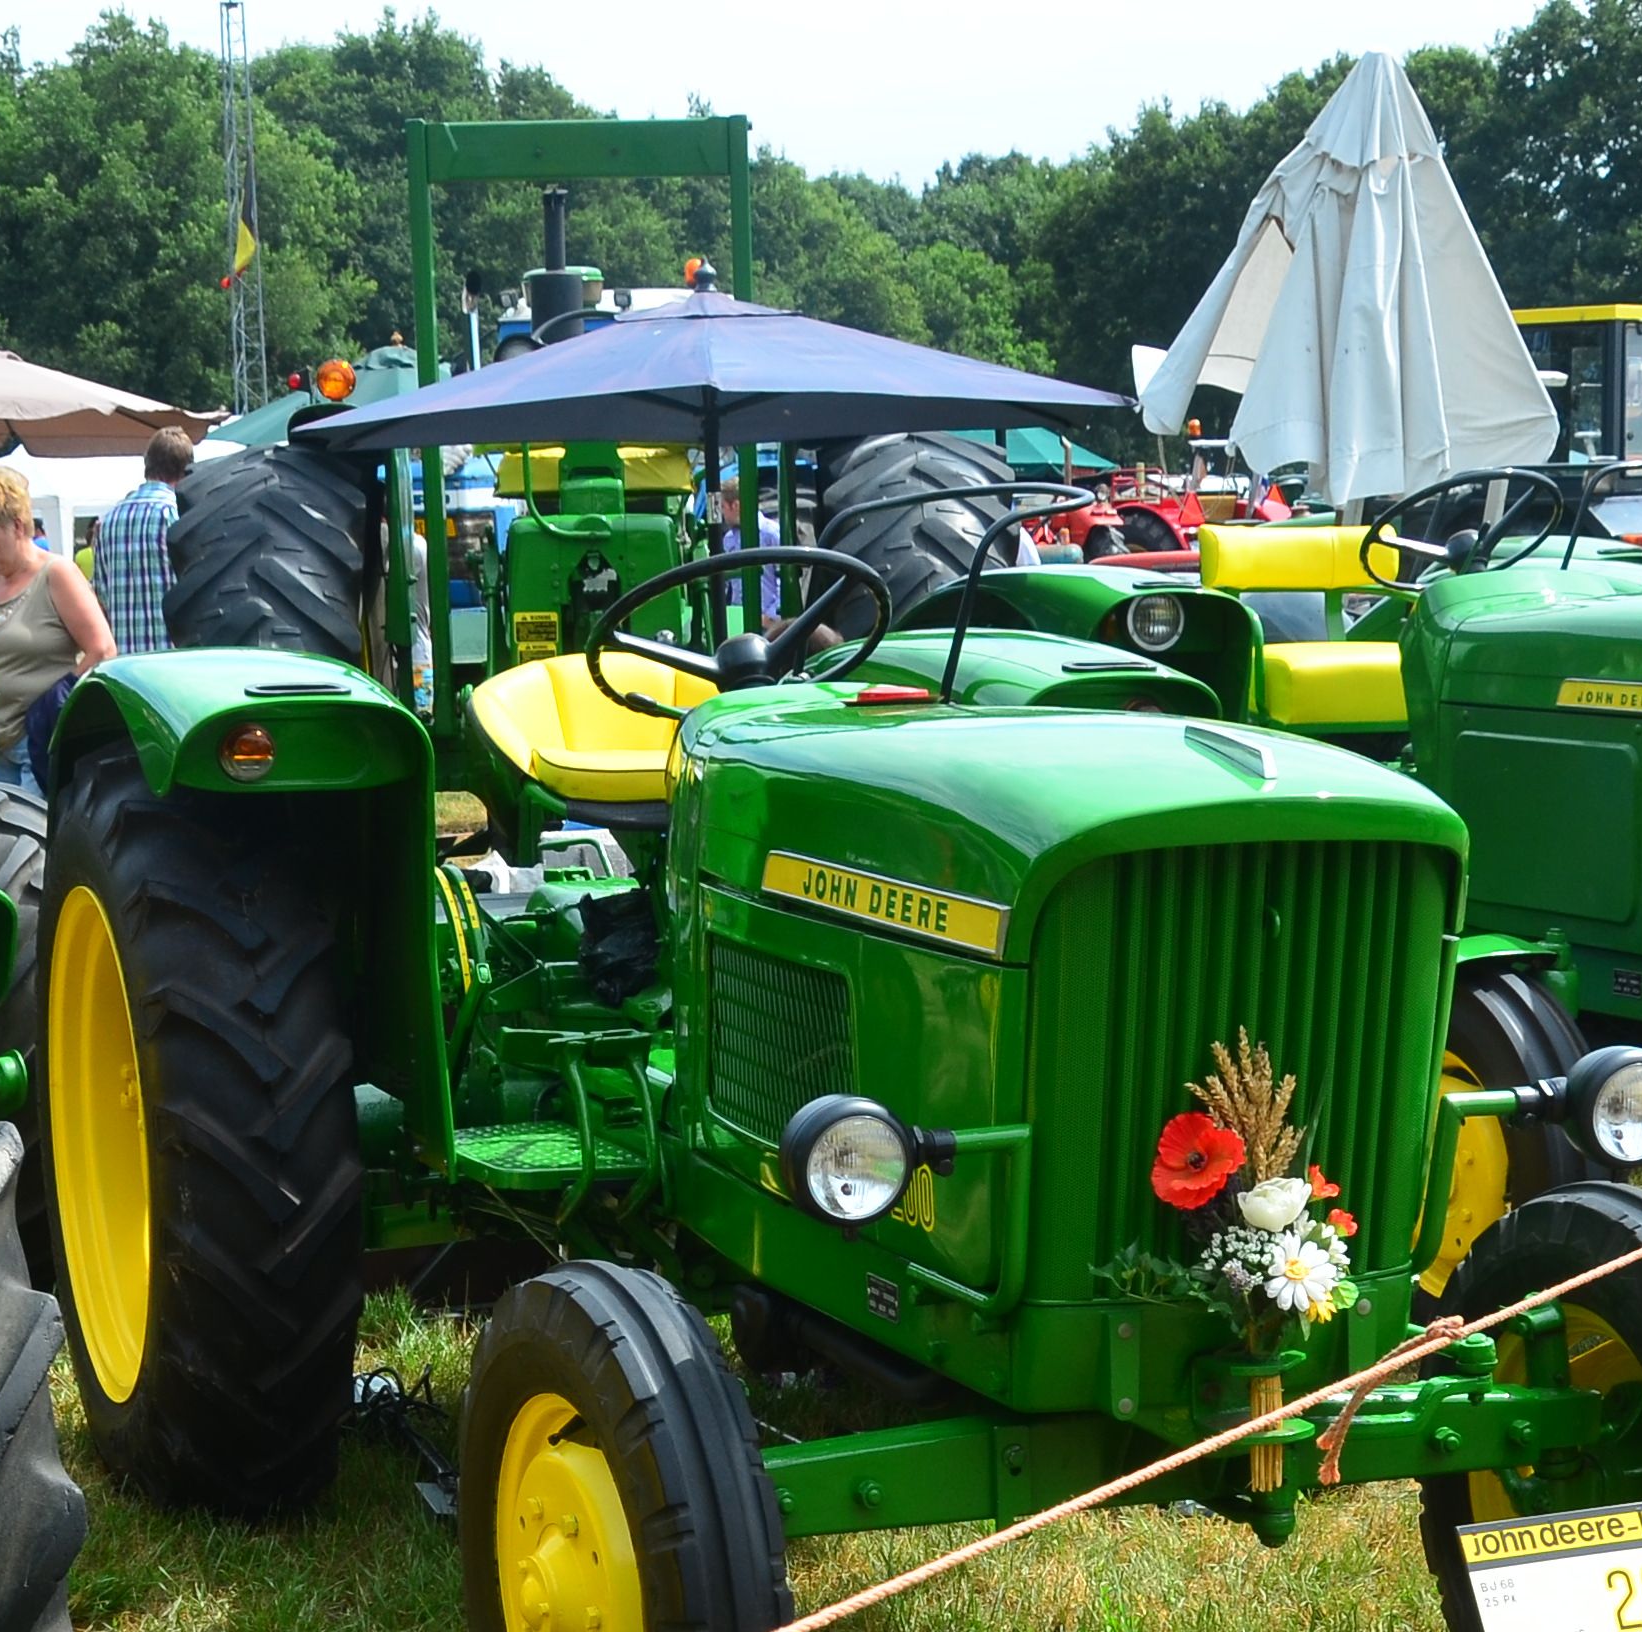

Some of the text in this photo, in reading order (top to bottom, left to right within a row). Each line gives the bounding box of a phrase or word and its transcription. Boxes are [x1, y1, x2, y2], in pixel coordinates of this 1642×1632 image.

[1577, 691, 1614, 704] JOHN
[803, 868, 949, 933] JOHN DEERE
[891, 1163, 934, 1232] 00
